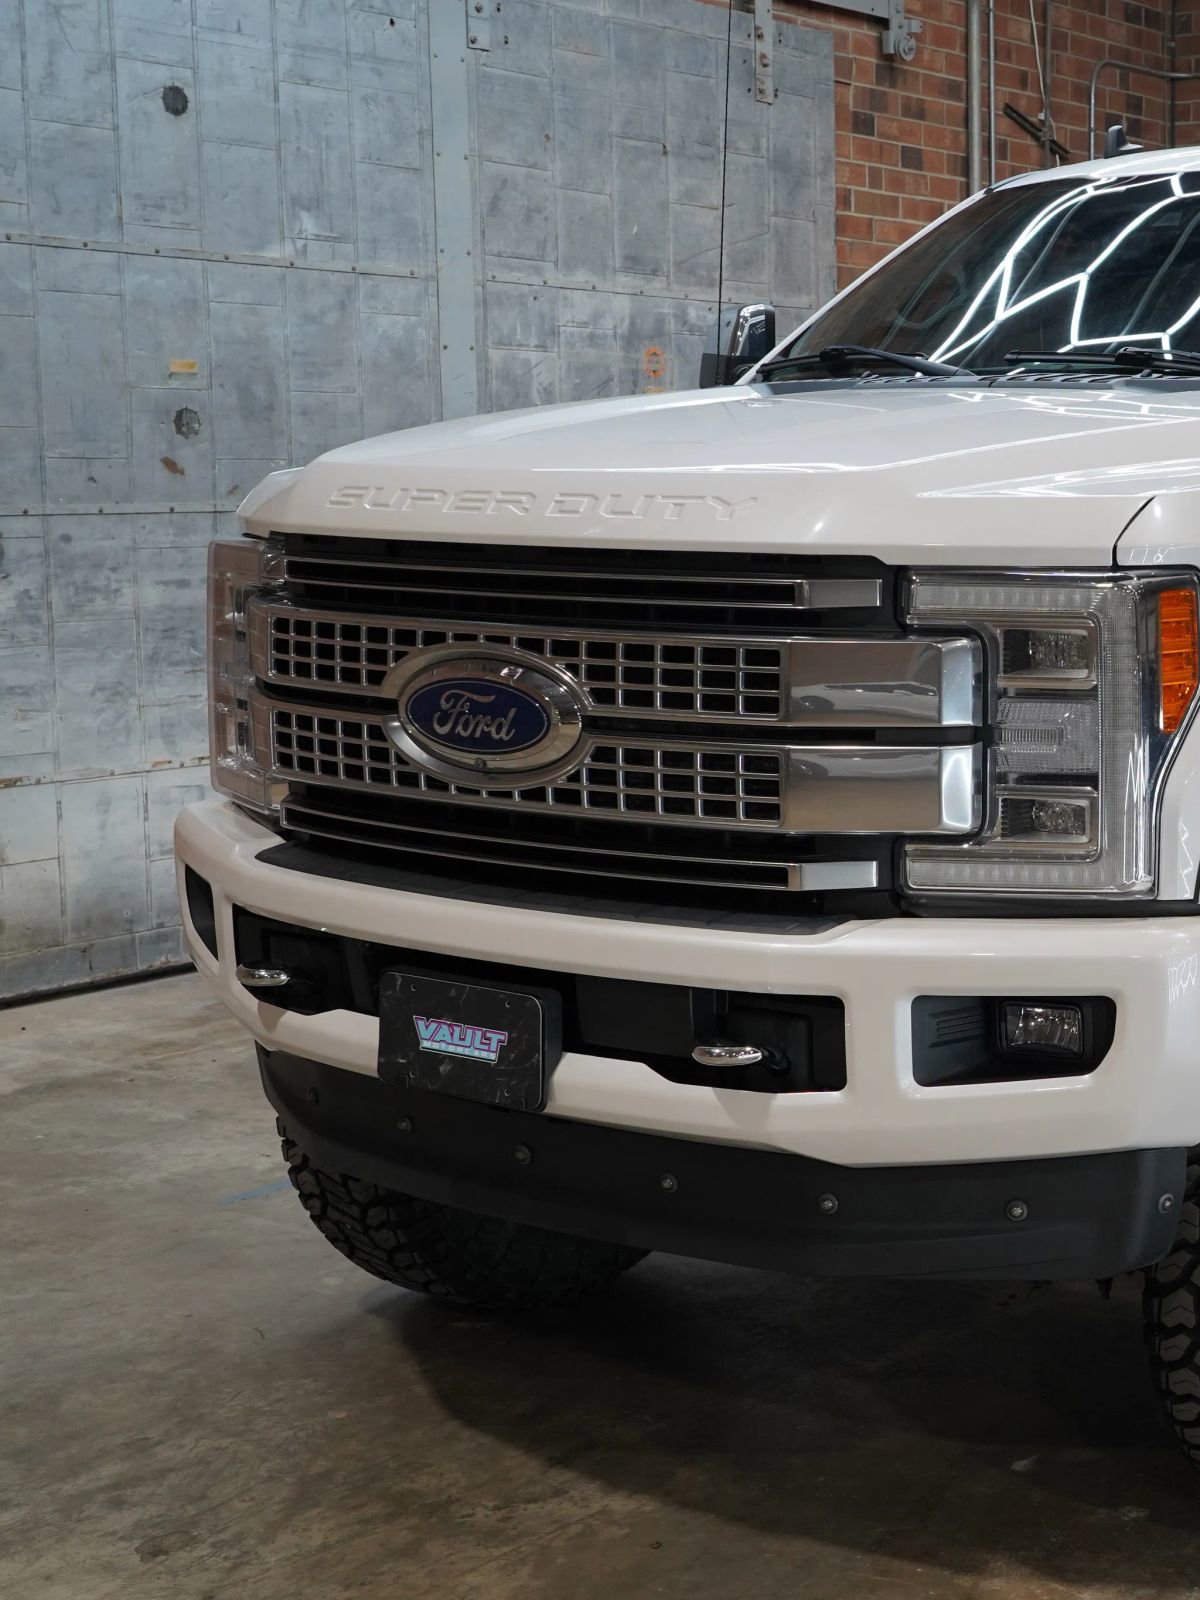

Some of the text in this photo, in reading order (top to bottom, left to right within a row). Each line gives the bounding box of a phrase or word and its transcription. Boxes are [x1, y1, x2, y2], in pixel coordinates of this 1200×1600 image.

[326, 486, 759, 520] SUPER DUTY
[432, 689, 517, 741] Ford
[414, 1016, 508, 1054] VAULT
